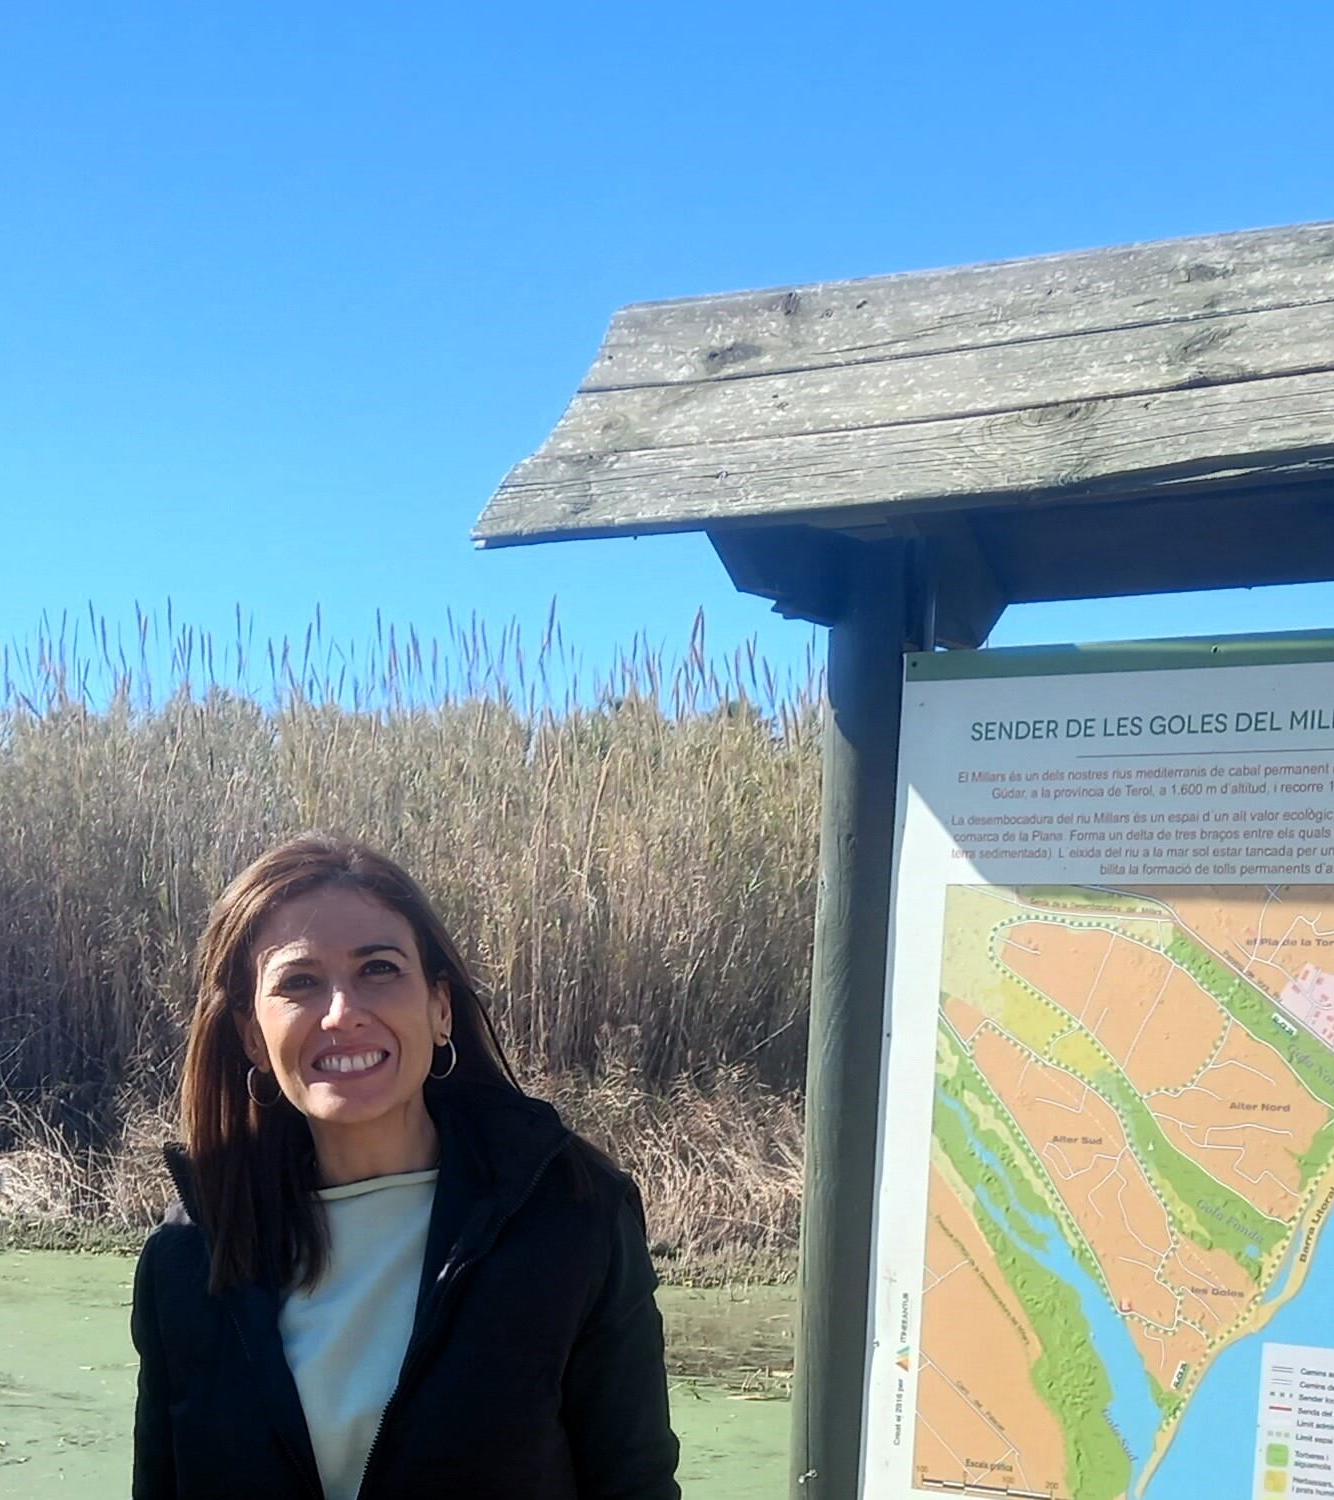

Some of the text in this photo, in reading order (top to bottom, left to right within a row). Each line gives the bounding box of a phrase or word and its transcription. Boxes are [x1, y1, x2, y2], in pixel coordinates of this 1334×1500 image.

[970, 719, 1059, 742] SENDER
[1065, 717, 1097, 739] DE
[1103, 715, 1143, 737] LES
[1149, 712, 1228, 736] GOLES
[1234, 711, 1283, 733] DEL
[957, 771, 969, 784] El
[971, 771, 1007, 783] Millars
[1008, 770, 1023, 783] és
[1024, 772, 1040, 782] un
[1041, 769, 1065, 786] dels
[1067, 768, 1109, 781] nostres
[1111, 767, 1133, 780] rius
[1134, 766, 1208, 780] mediterranis
[1209, 764, 1226, 778] de
[1227, 763, 1261, 777] cabal
[1263, 762, 1330, 780] permanent
[1230, 1102, 1291, 1112] Alter Nord
[1052, 1136, 1103, 1145] Alter Sud
[1299, 1227, 1315, 1263] Barra
